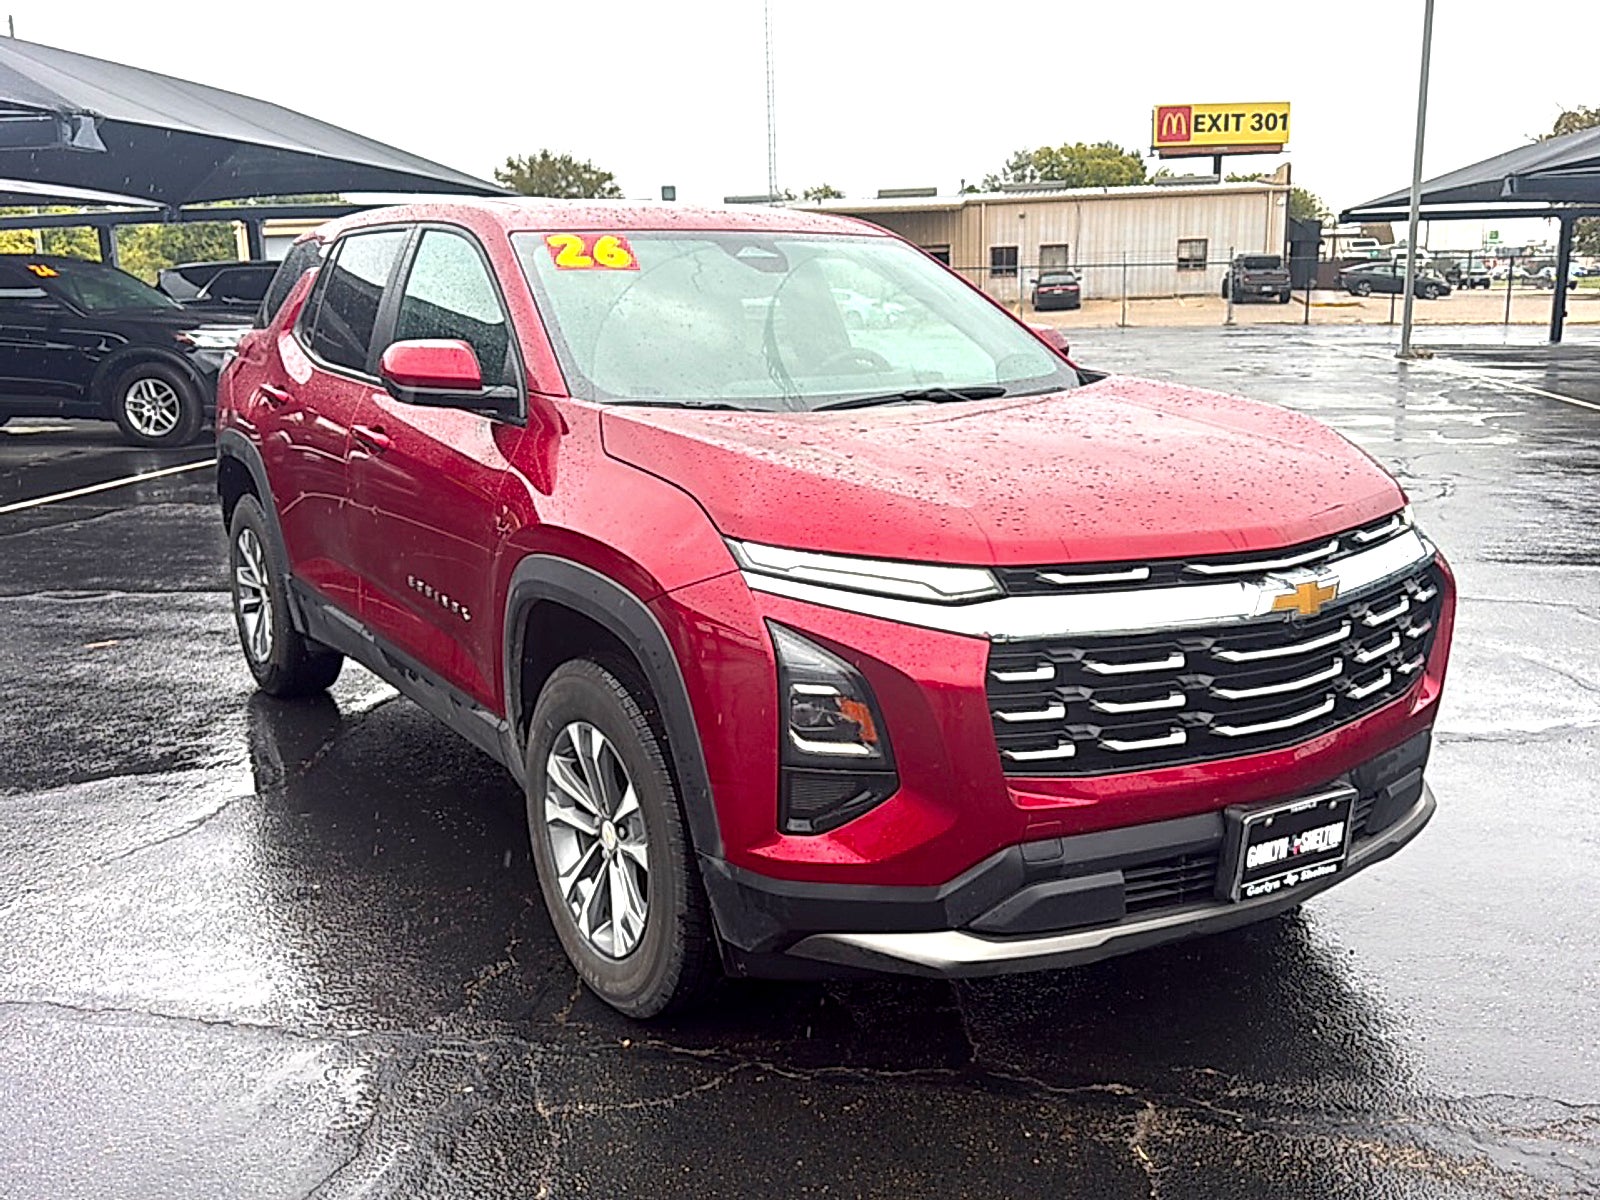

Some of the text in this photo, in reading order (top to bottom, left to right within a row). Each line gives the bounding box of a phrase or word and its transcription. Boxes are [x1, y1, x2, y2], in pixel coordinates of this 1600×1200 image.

[1193, 112, 1289, 133] EXIT 301
[546, 233, 632, 269] 26
